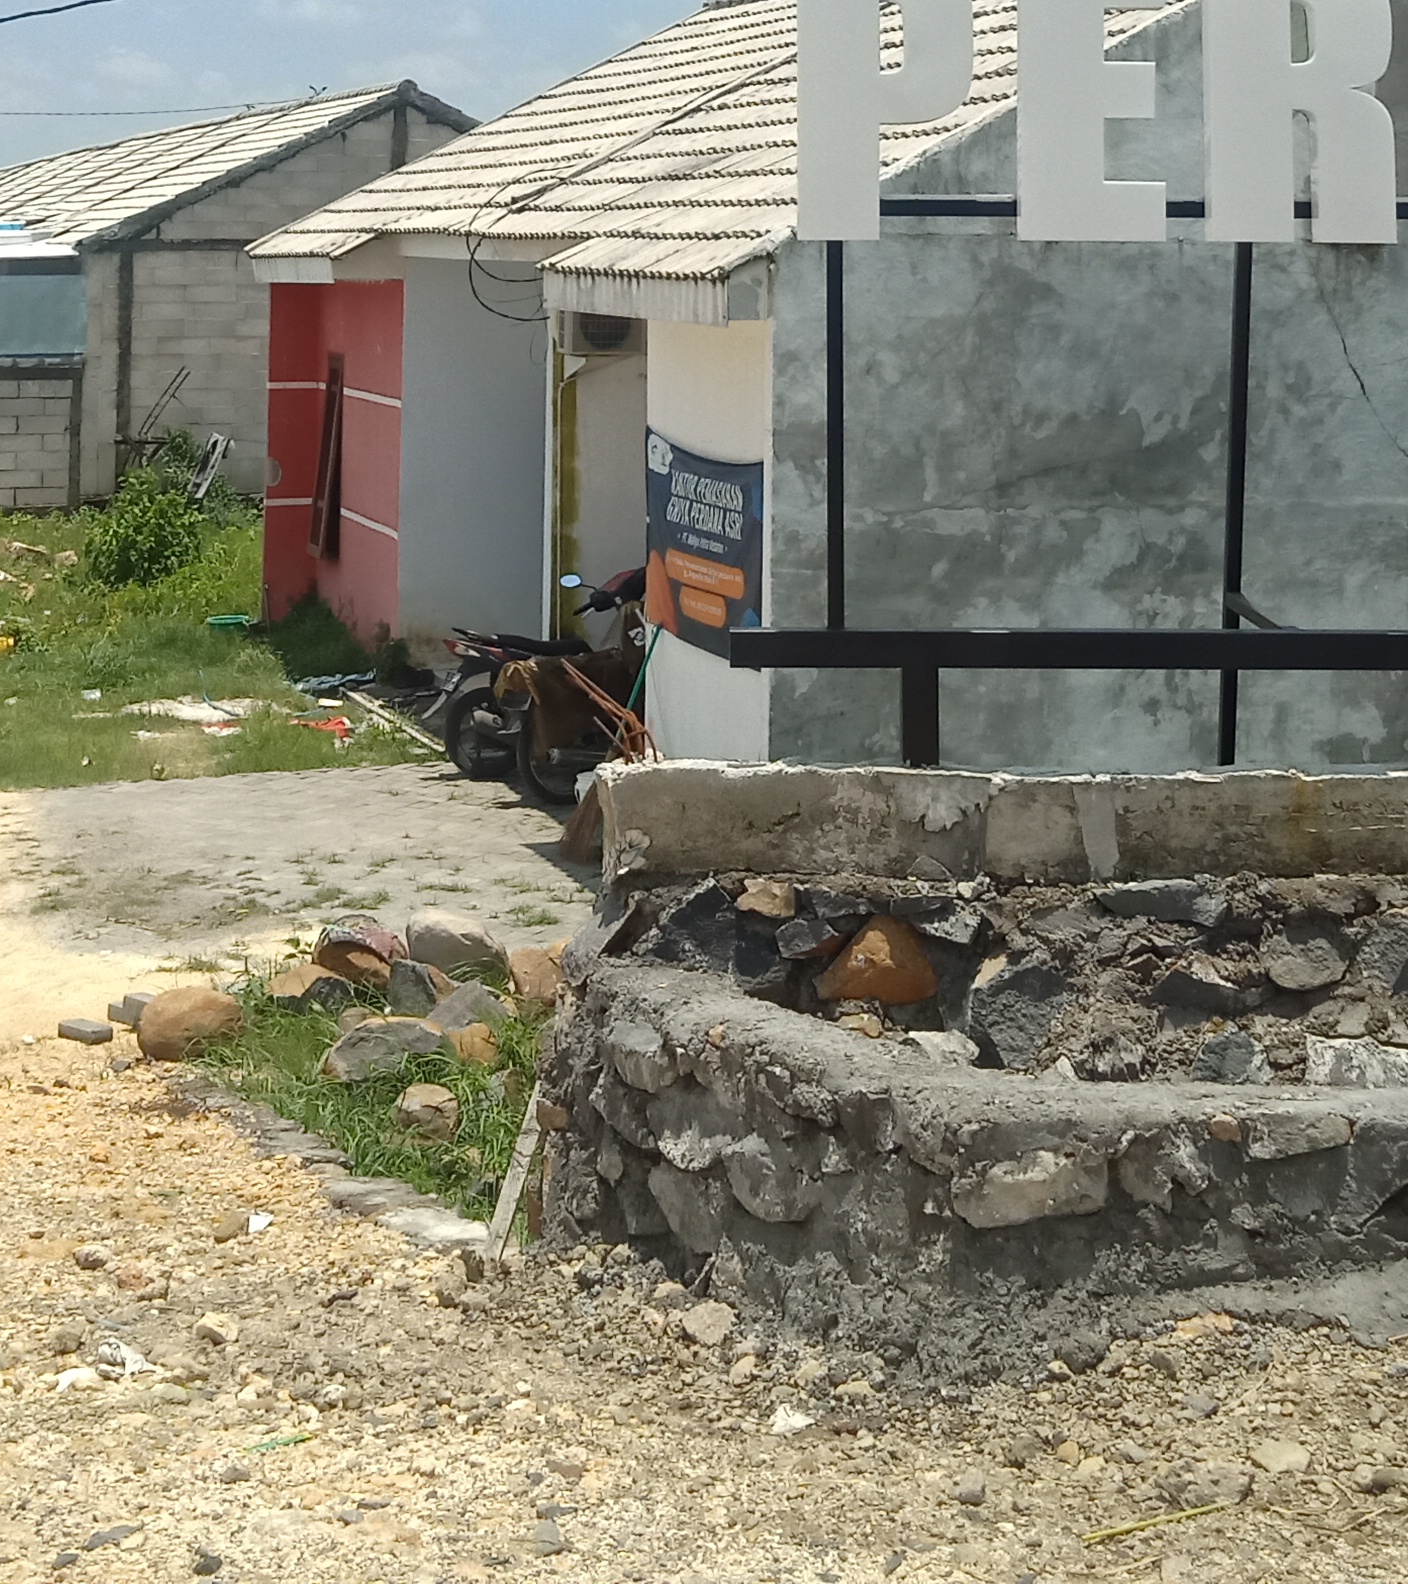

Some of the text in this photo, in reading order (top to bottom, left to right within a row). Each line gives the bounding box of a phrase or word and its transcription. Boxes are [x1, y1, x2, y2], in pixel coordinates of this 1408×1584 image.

[671, 468, 698, 501] KANTOR
[666, 496, 743, 540] GRIYA PERDANA ASRI
